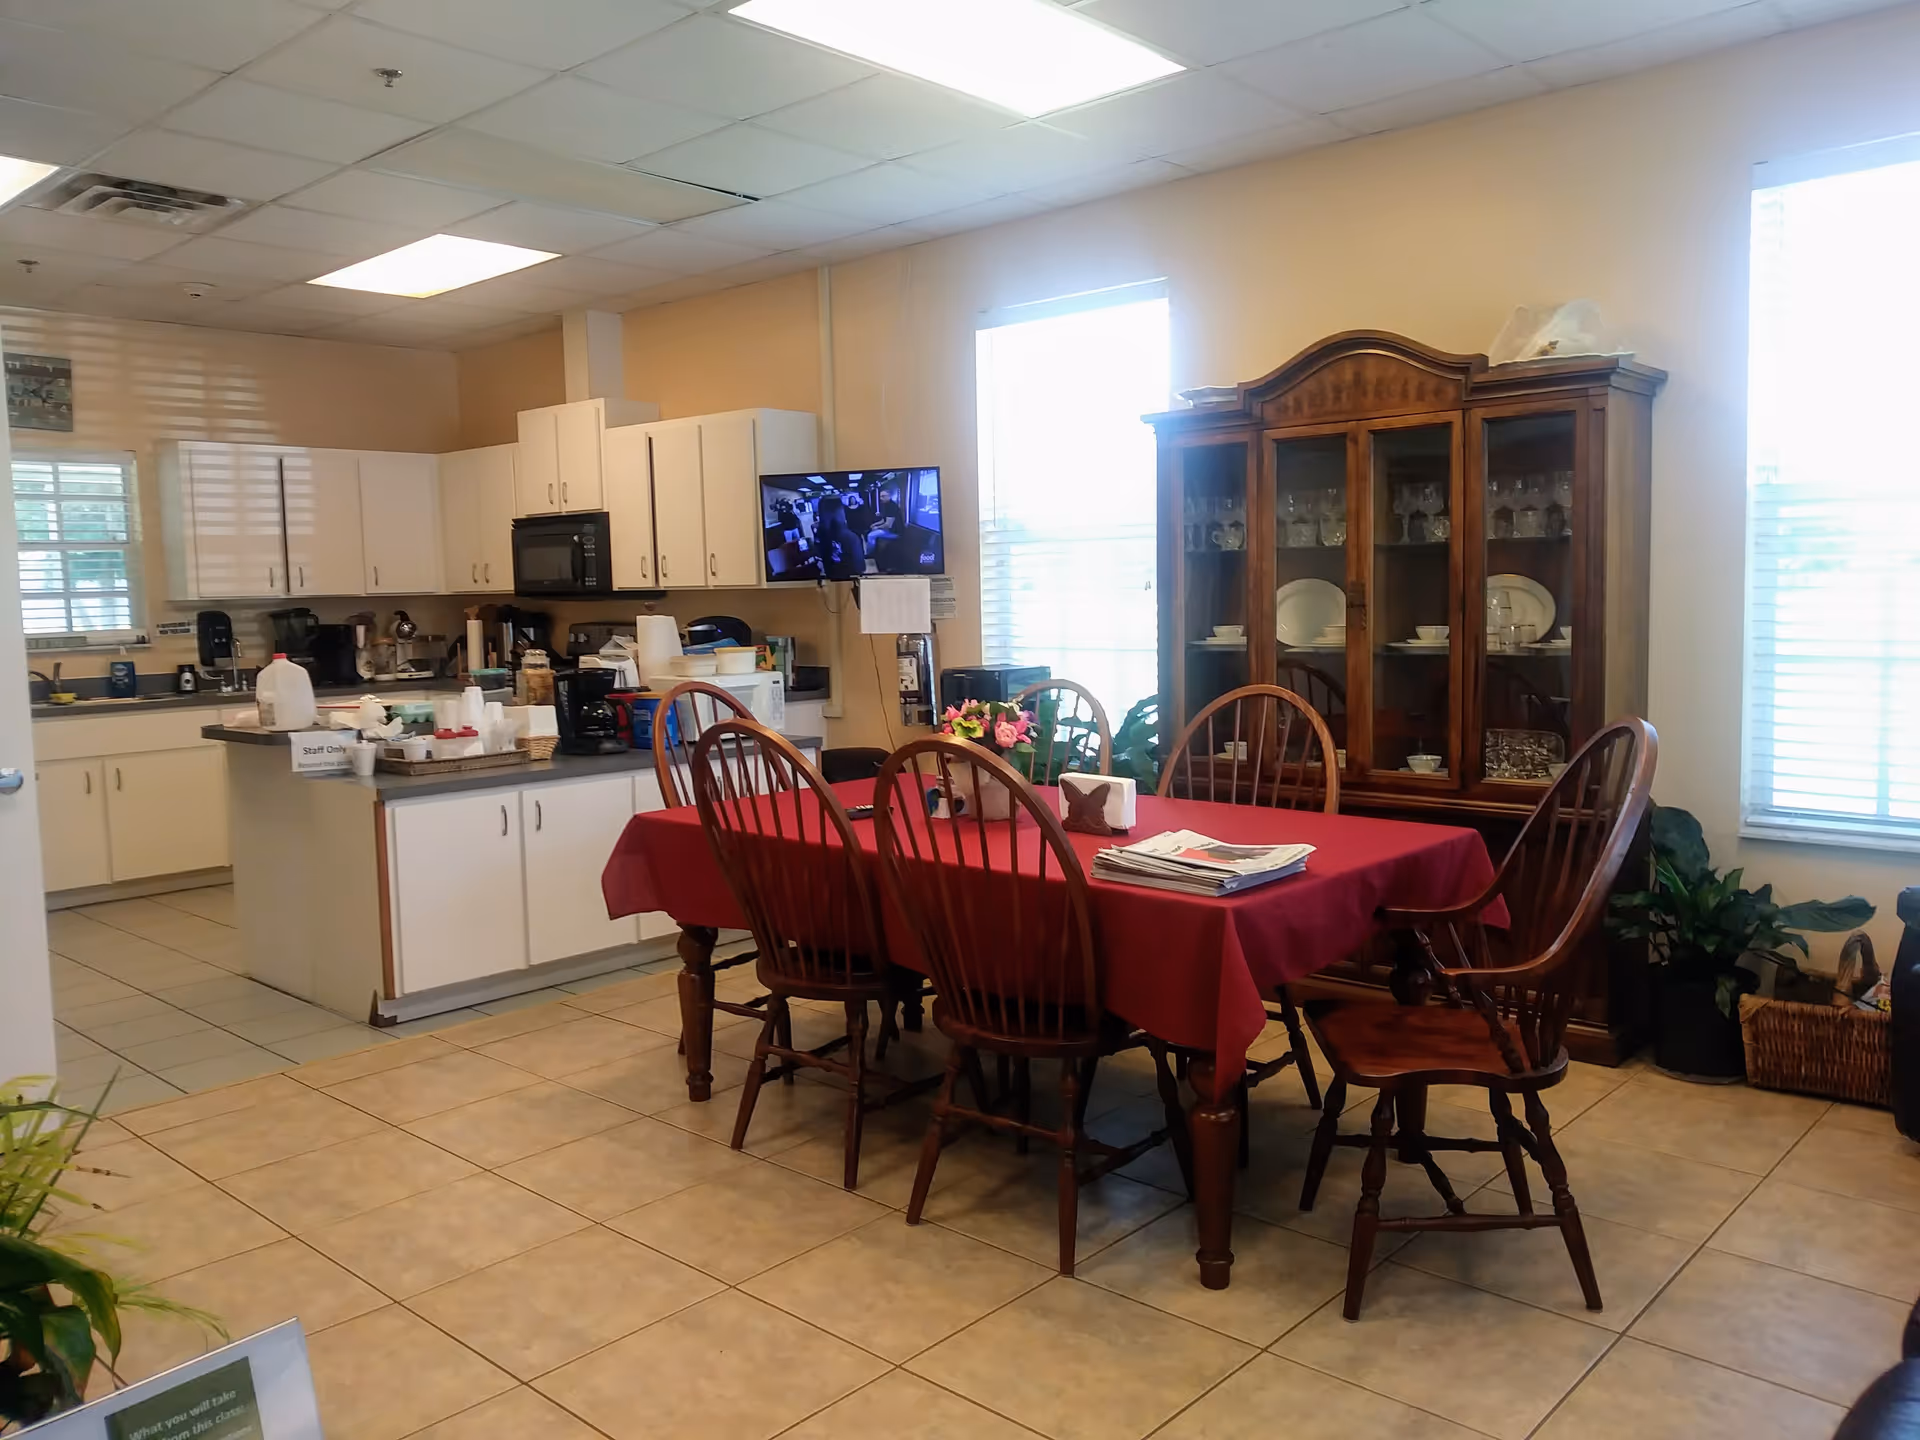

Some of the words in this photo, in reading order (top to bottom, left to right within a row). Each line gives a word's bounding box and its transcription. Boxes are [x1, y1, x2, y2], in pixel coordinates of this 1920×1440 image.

[920, 553, 935, 564] food
[303, 746, 325, 755] Staff
[326, 745, 346, 754] Only
[129, 1422, 162, 1440] What
[165, 1412, 188, 1429] you
[189, 1399, 210, 1417] will
[212, 1390, 237, 1407] take
[192, 1419, 214, 1435] this
